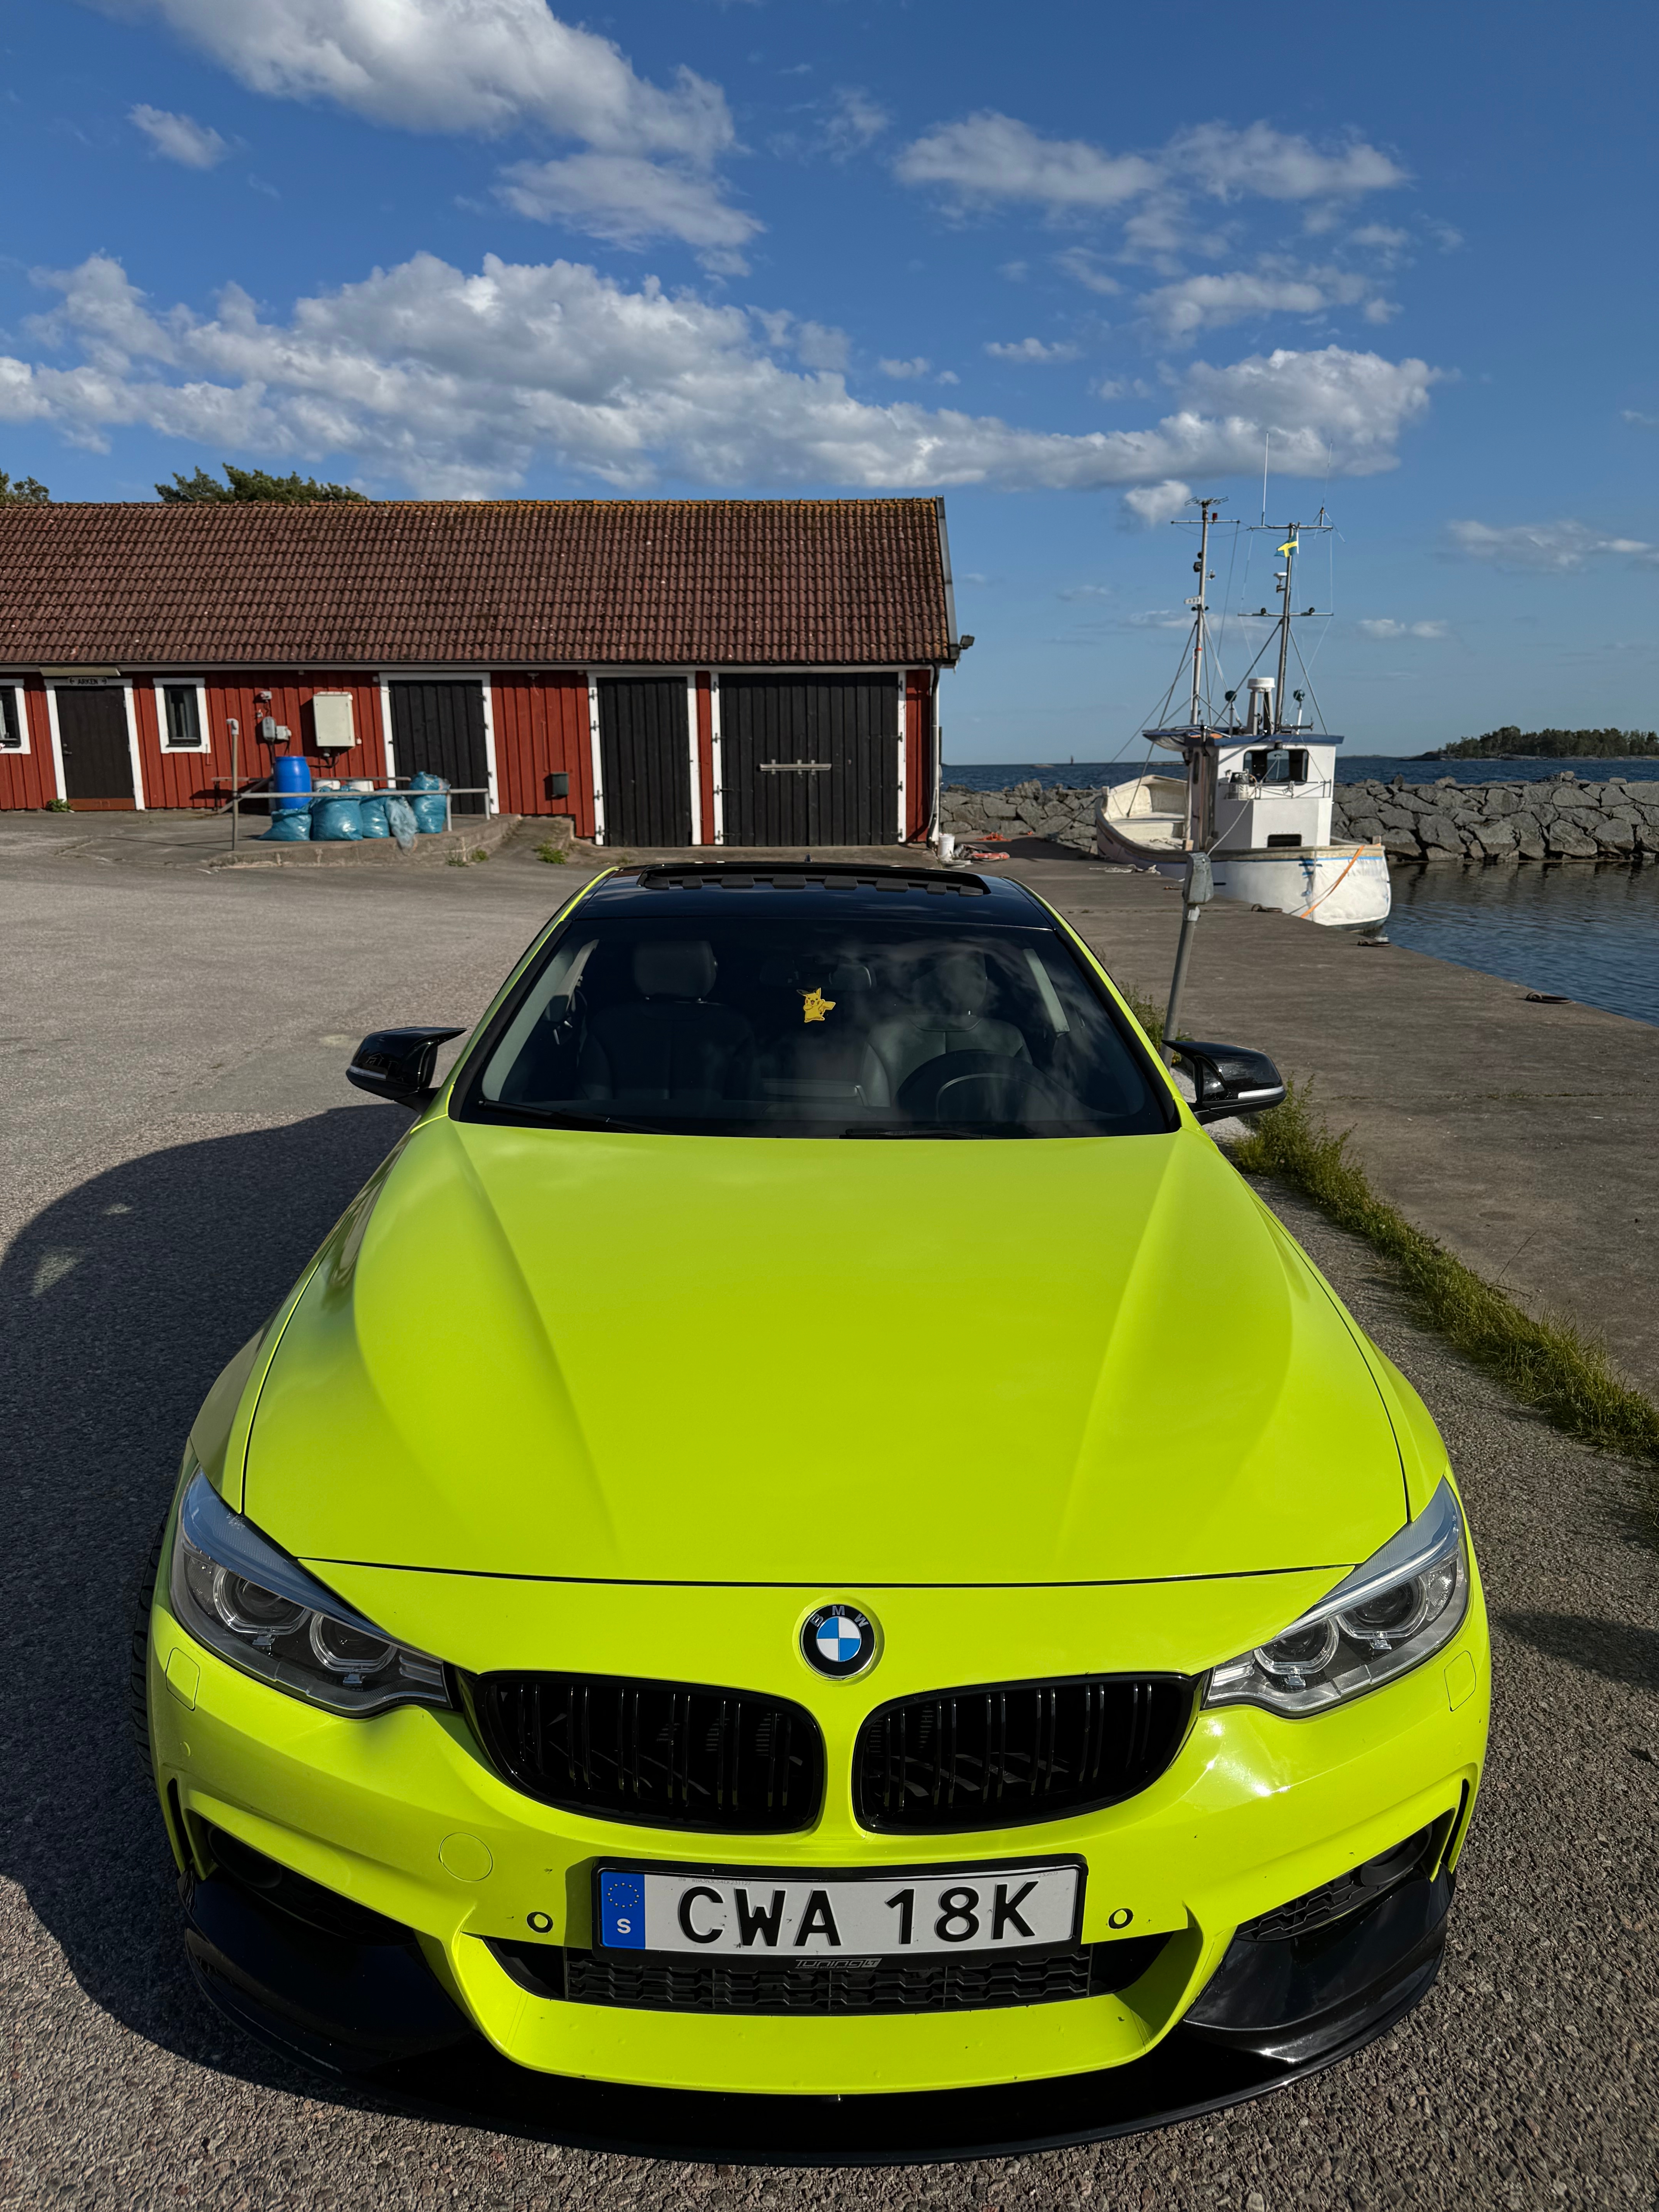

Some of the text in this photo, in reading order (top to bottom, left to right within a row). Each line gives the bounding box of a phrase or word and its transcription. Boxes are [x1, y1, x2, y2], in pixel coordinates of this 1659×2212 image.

[810, 1605, 869, 1627] BMW
[678, 1881, 1039, 1946] CWA 18K
[617, 1918, 631, 1934] S
